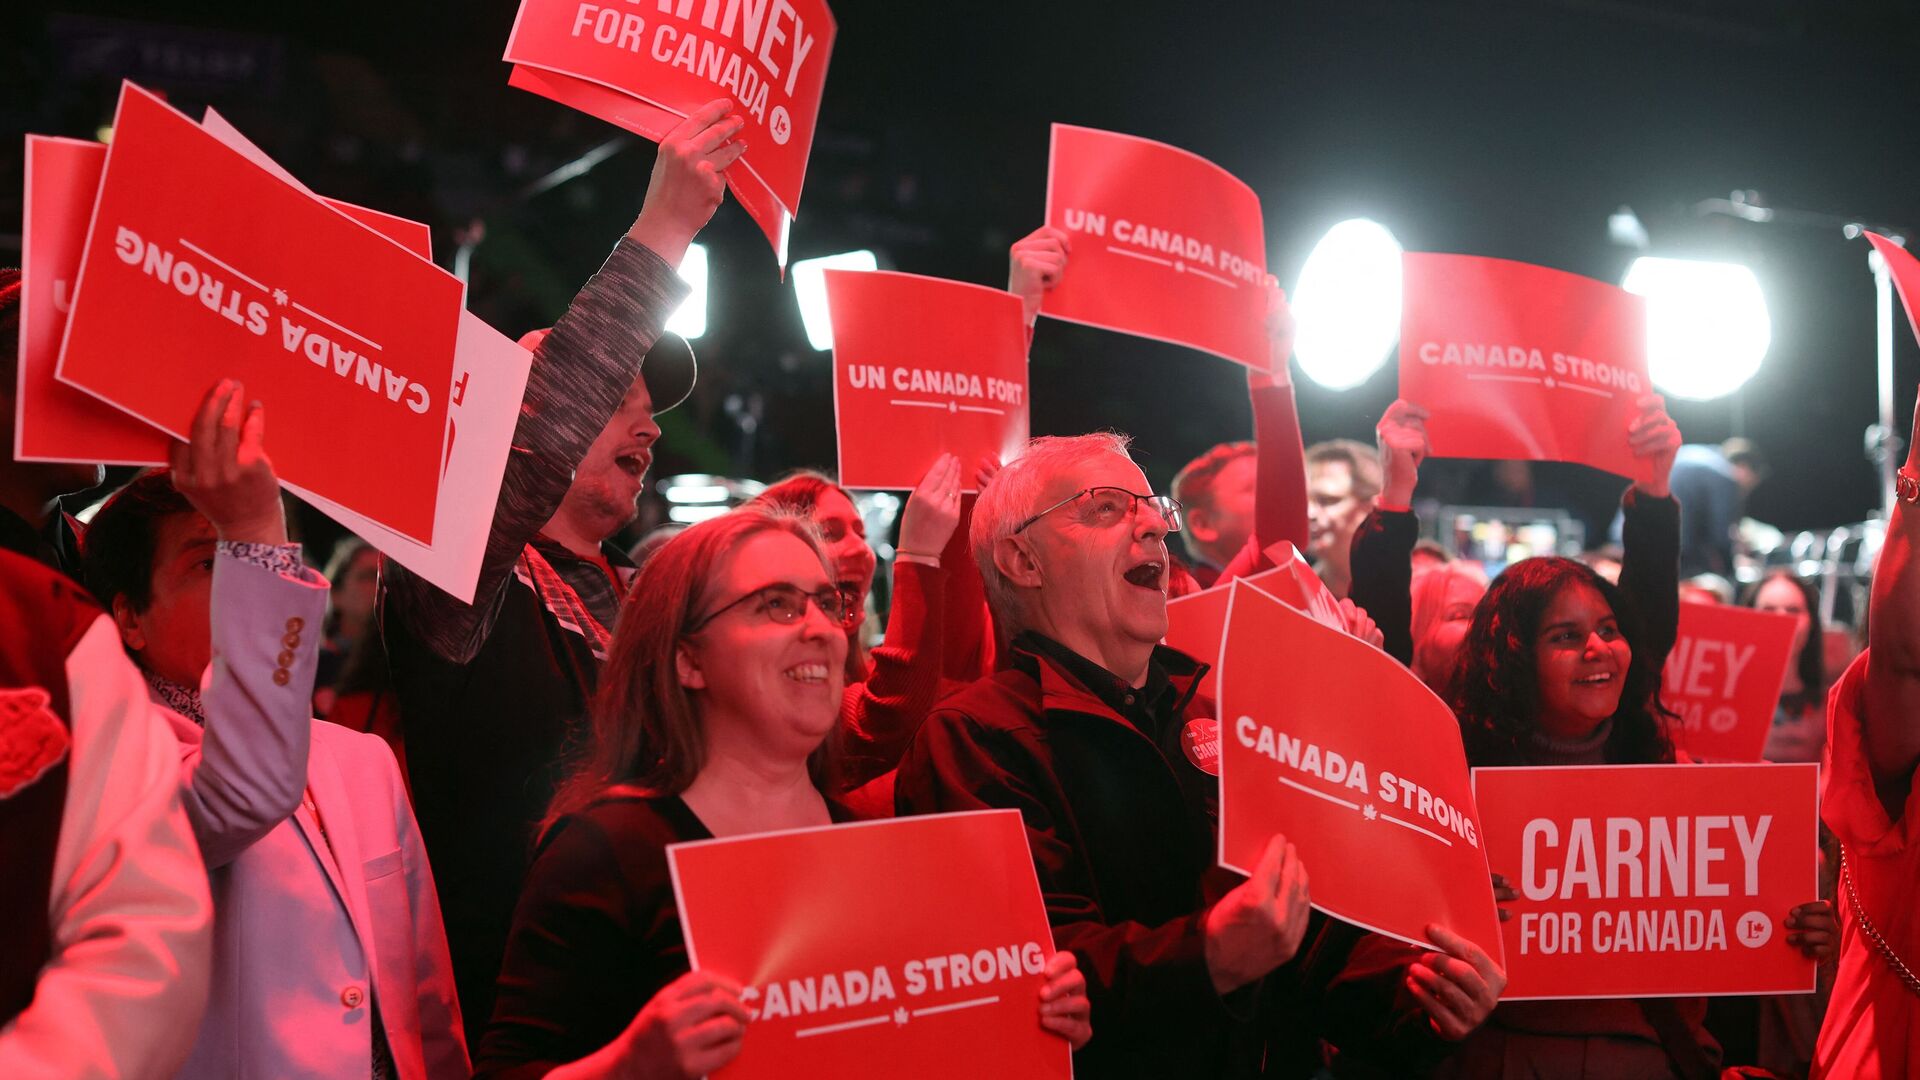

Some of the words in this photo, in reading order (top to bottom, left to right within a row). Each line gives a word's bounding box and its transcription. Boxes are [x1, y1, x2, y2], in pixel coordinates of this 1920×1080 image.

[571, 3, 645, 53] FOR
[651, 24, 769, 126] CANADA
[114, 225, 270, 337] STRONG
[1064, 208, 1107, 237] UN
[1112, 219, 1214, 267] CANADA
[1219, 250, 1264, 288] FORT
[280, 316, 431, 415] CANADA
[848, 364, 886, 390] UN
[892, 367, 984, 399] CANADA
[986, 377, 1023, 406] FORT
[1418, 342, 1546, 372] CANADA
[1552, 351, 1643, 393] STRONG
[1236, 715, 1369, 794] CANADA
[1378, 771, 1478, 848] STRONG
[1521, 814, 1773, 901] CARNEY
[904, 941, 1046, 996] STRONG
[1520, 912, 1582, 955] FOR
[1592, 909, 1728, 953] CANADA
